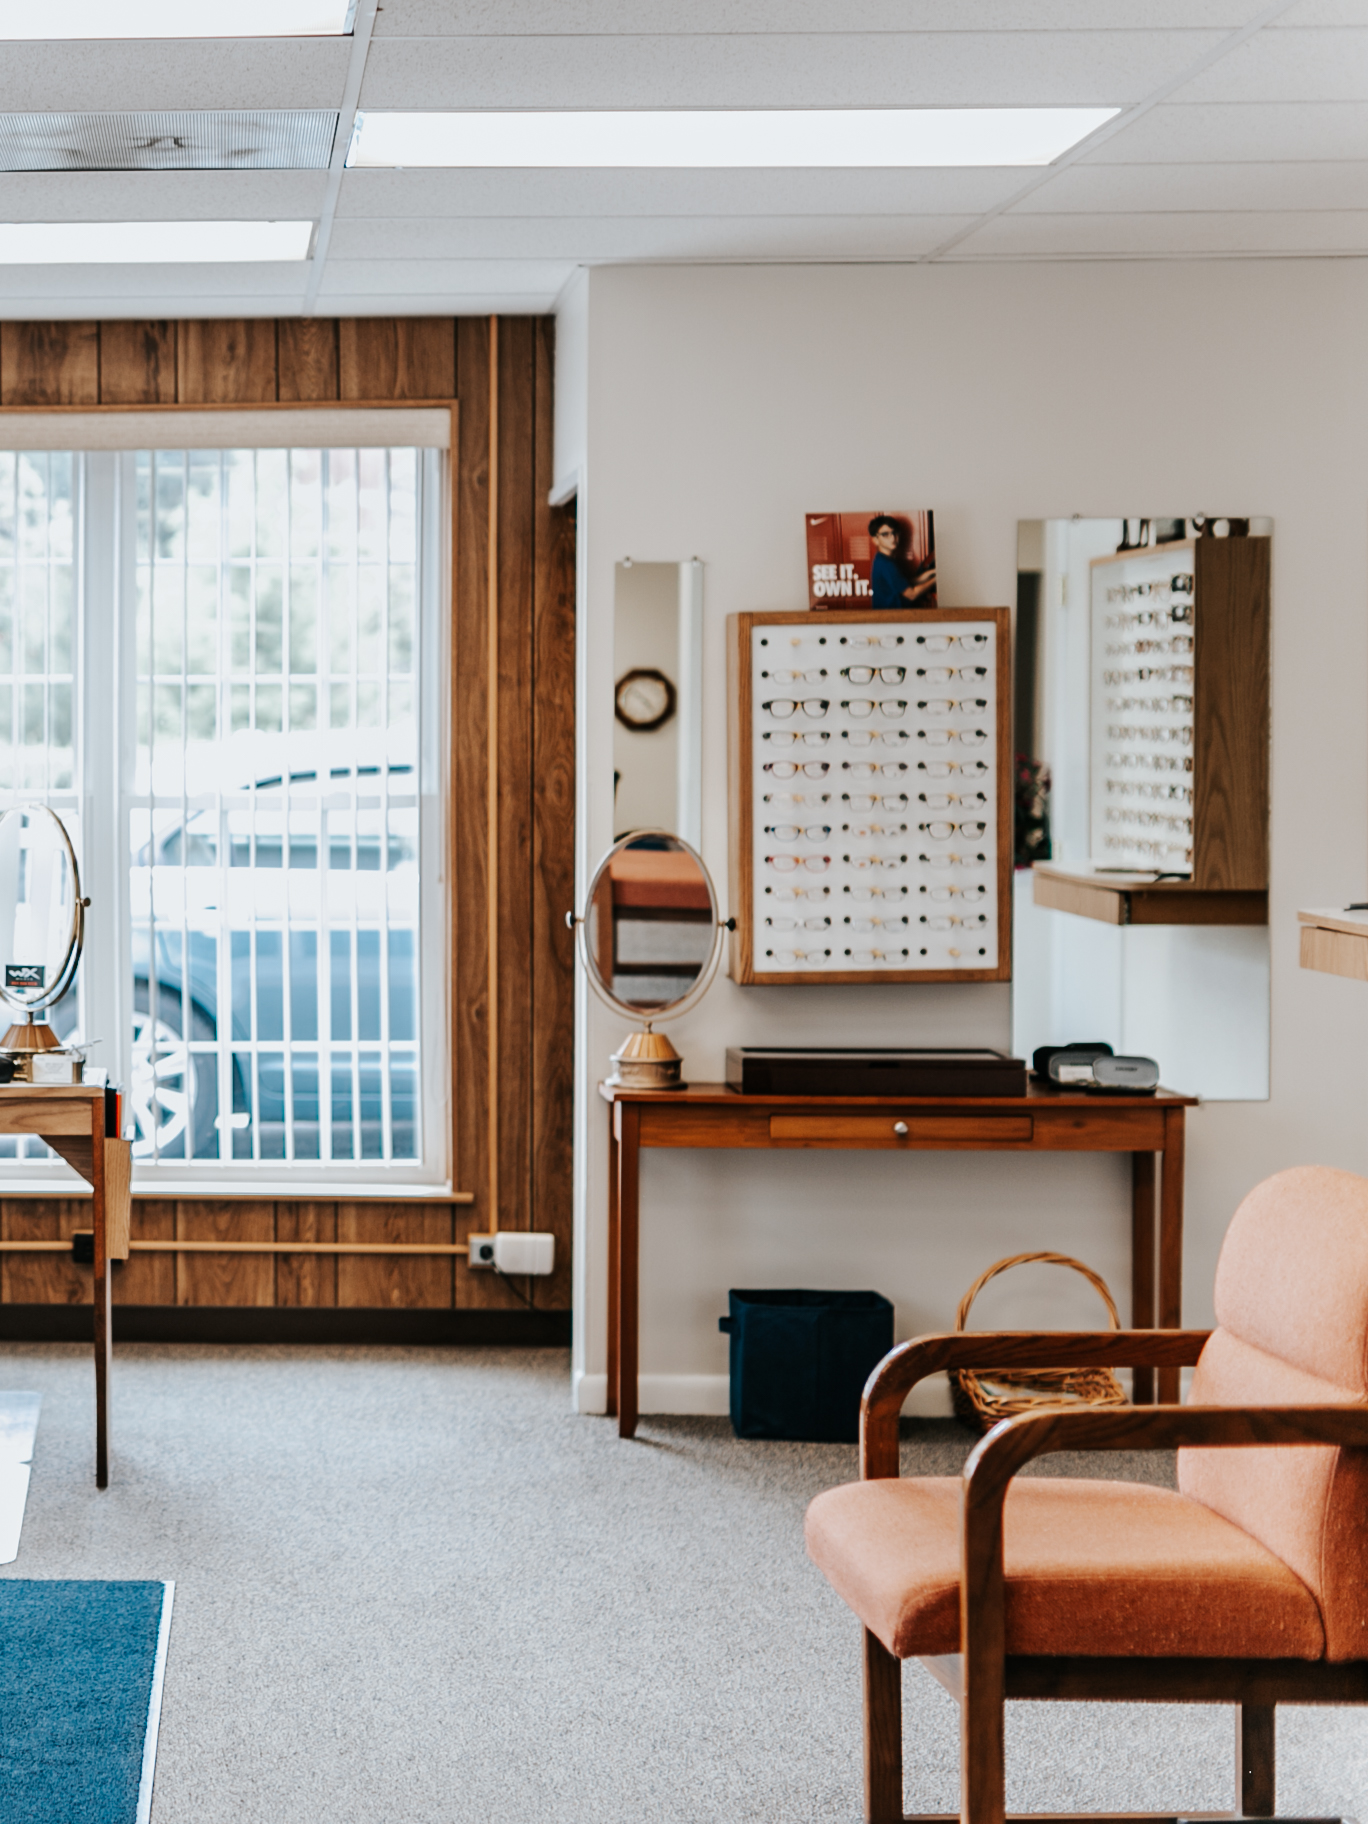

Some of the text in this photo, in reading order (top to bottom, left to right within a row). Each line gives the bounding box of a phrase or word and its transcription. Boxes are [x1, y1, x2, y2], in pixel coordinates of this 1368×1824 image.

[812, 563, 859, 580] SEE IT.
[813, 579, 874, 597] OWN IT.
